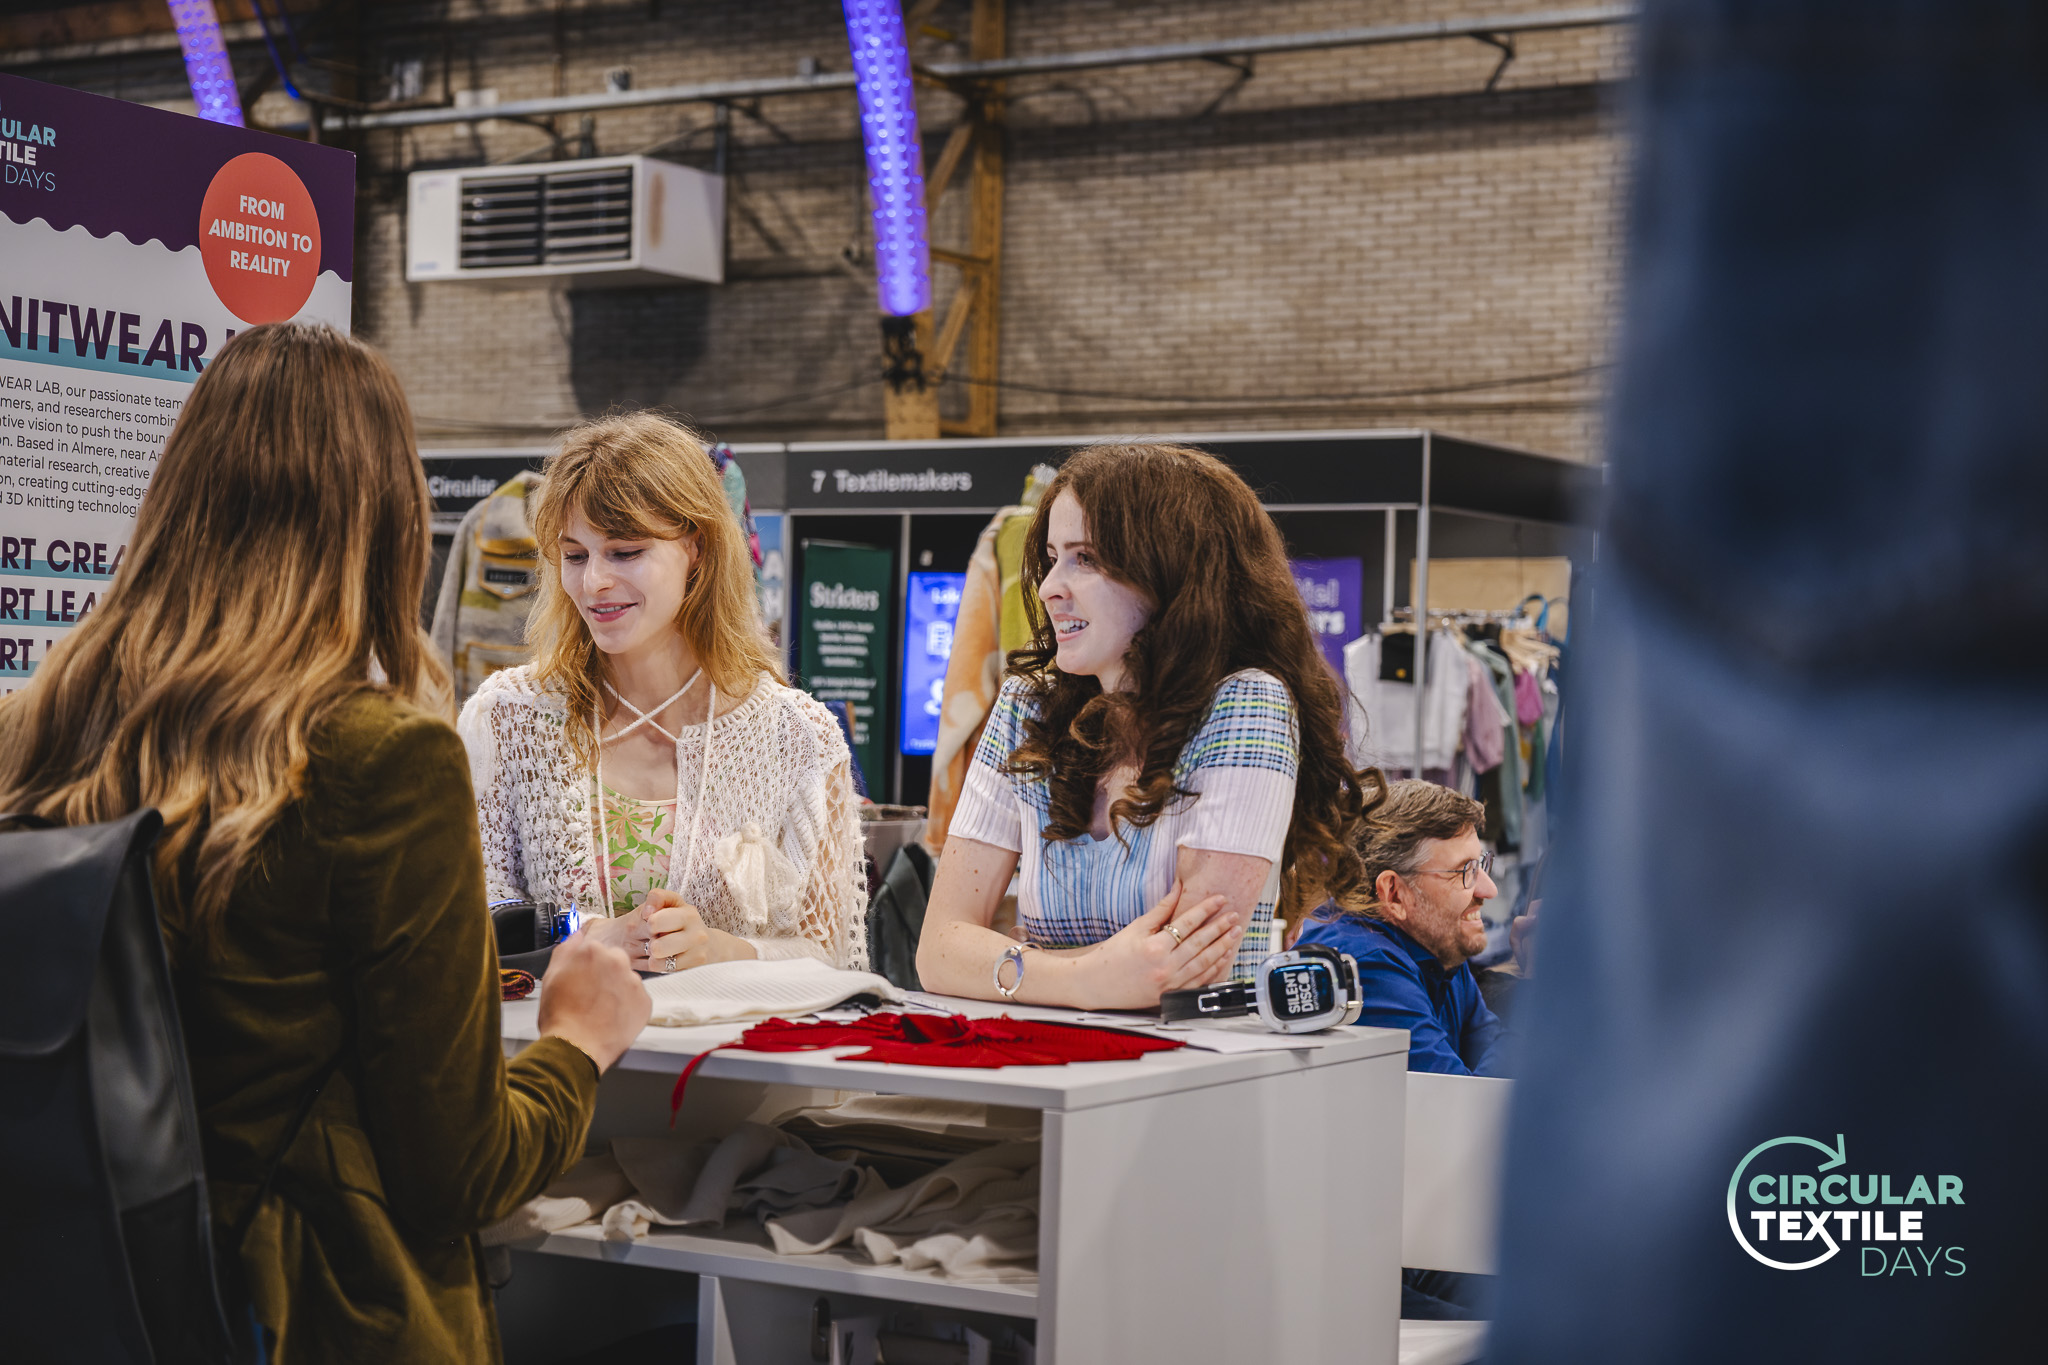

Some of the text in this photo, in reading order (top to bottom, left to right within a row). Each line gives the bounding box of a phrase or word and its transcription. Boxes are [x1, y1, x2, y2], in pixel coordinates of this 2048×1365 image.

[0, 117, 57, 148] ULAR
[5, 164, 56, 192] DAYS
[239, 194, 285, 221] FROM
[208, 218, 313, 254] AMBITION TO
[230, 250, 291, 277] REALITY
[35, 380, 63, 397] LAB,
[66, 386, 86, 398] our
[89, 388, 152, 406] passionate
[154, 395, 184, 410] team
[37, 401, 60, 414] and
[64, 405, 131, 422] researchers
[0, 414, 25, 429] tive
[28, 417, 63, 433] vision
[66, 422, 78, 435] to
[81, 425, 110, 439] push
[114, 427, 133, 441] the
[16, 435, 54, 451] Based
[57, 439, 68, 452] in
[72, 441, 117, 460] Almere,
[120, 448, 146, 461] near
[48, 459, 102, 477] research,
[104, 465, 150, 480] creative
[811, 467, 972, 493] 7 Textilemakers
[18, 476, 68, 493] creating
[72, 480, 149, 500] cutting-edge
[6, 492, 24, 505] 3D
[27, 493, 74, 513] knitting
[1283, 971, 1301, 1014] SILENT
